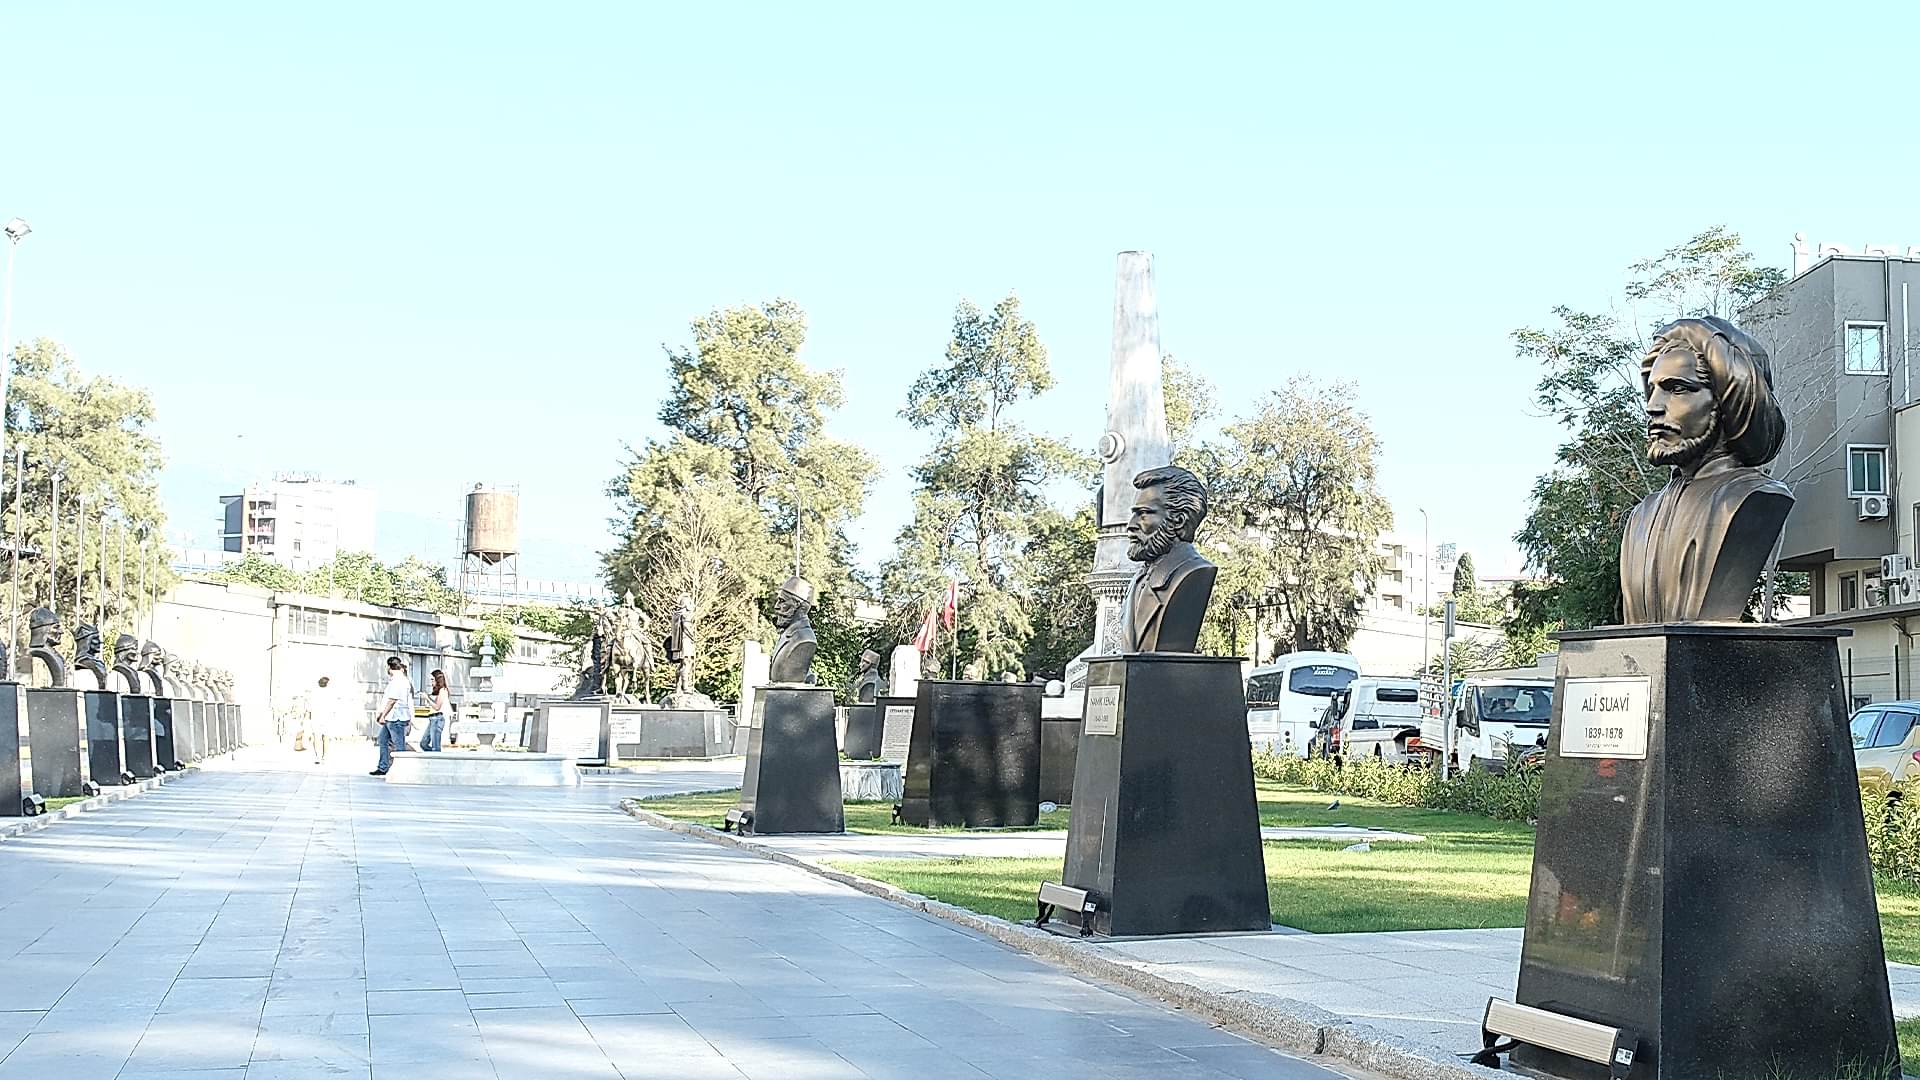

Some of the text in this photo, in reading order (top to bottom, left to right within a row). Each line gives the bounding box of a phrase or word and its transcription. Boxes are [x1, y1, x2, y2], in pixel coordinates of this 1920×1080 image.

[1581, 692, 1630, 712] ALİ SUAVİ
[1584, 727, 1624, 739] 1839-1878
